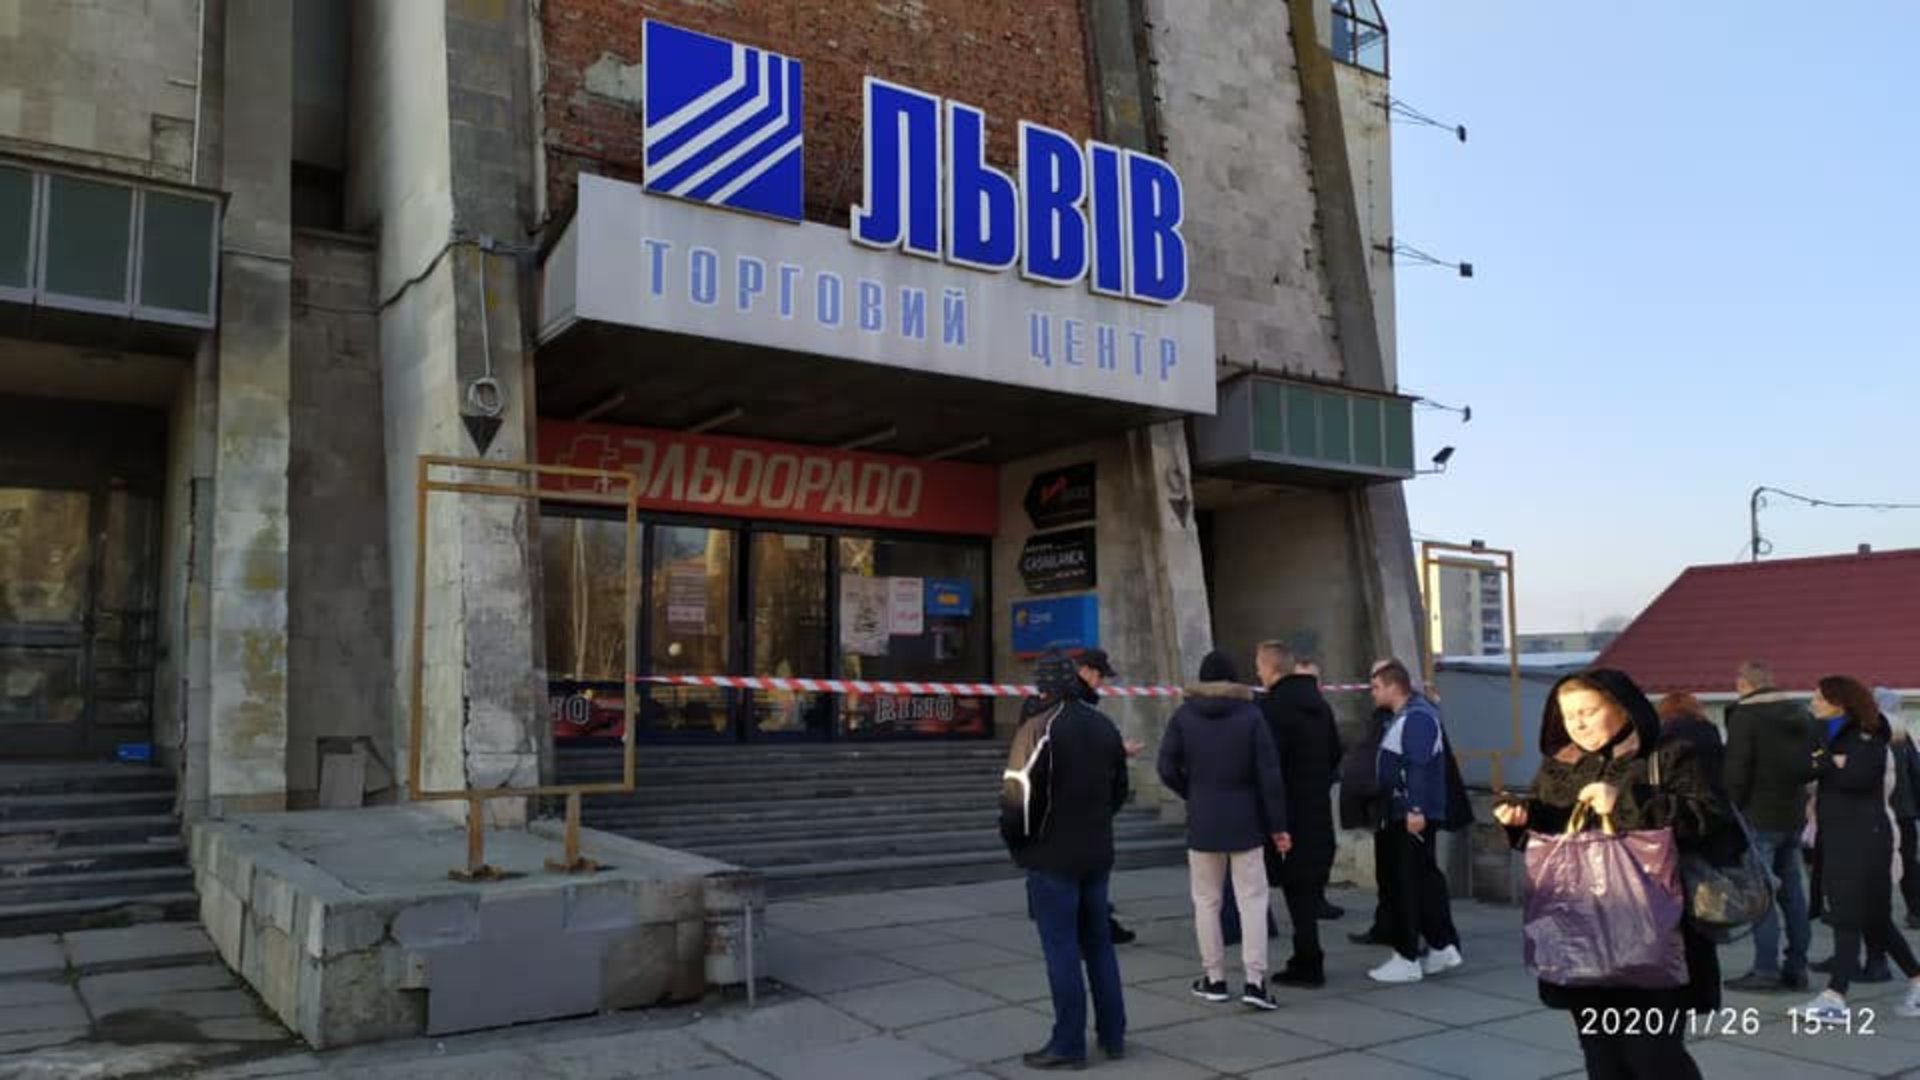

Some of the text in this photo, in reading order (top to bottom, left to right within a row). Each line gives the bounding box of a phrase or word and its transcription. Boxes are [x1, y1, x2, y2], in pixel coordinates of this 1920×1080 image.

[850, 75, 1188, 304] ЛЬВІВ
[644, 239, 1178, 381] ТОРГОВИЙ ЦЕНТР
